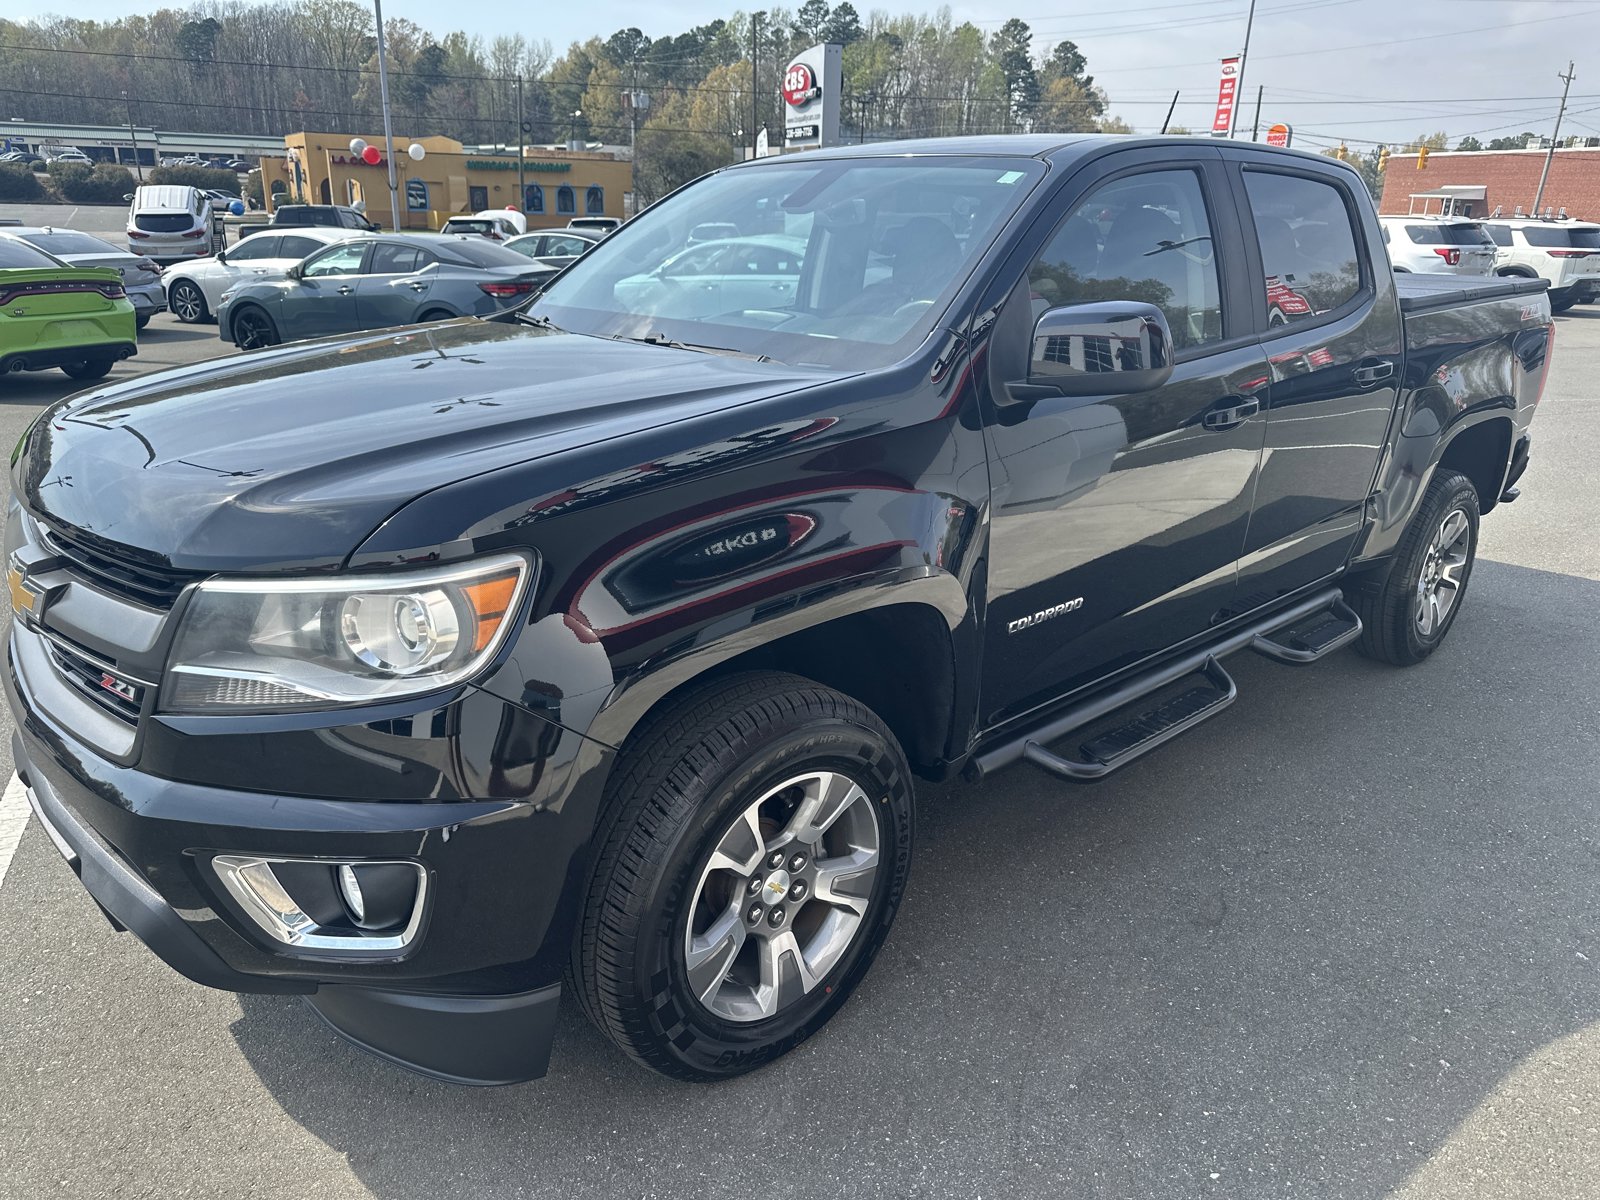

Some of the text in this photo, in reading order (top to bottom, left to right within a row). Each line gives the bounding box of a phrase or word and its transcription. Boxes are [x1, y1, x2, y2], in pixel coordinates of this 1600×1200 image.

[785, 69, 805, 92] CBS
[332, 155, 350, 165] LA
[1520, 303, 1542, 320] Z71
[1007, 597, 1084, 634] COLORADO
[101, 672, 136, 702] Z71
